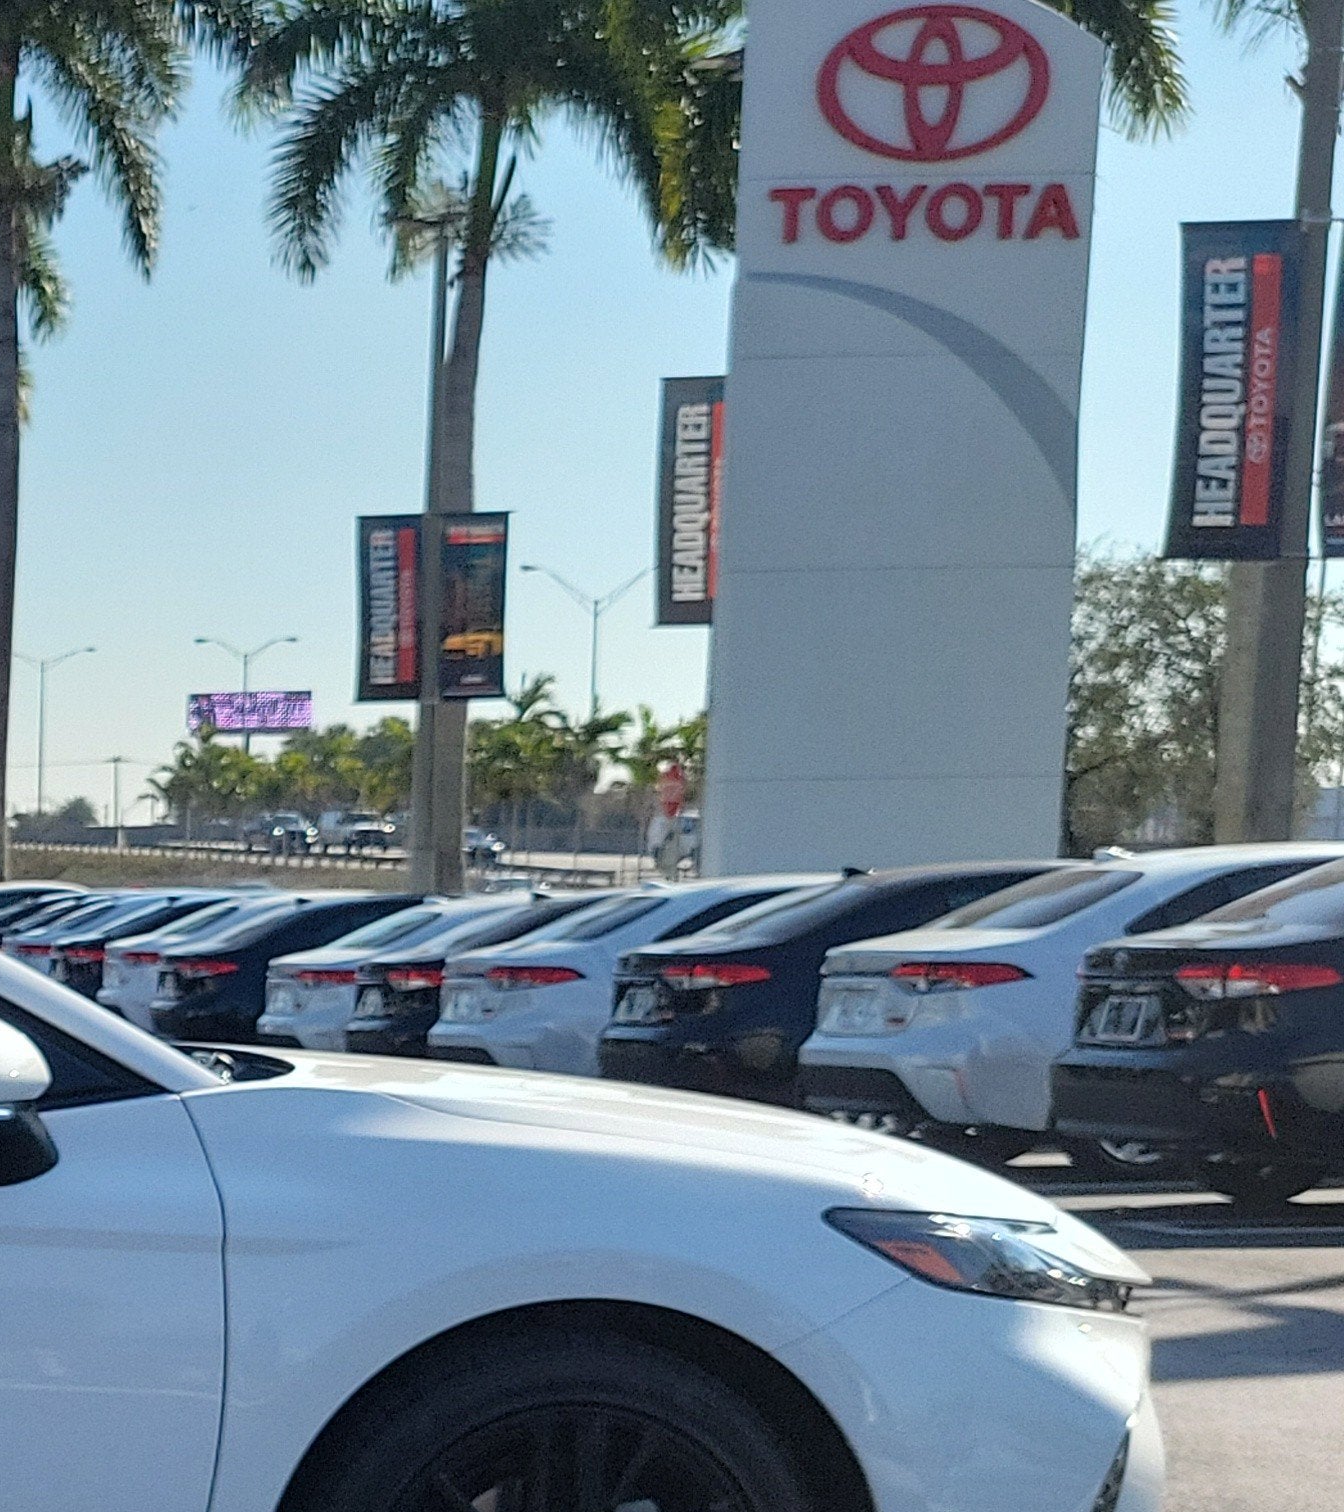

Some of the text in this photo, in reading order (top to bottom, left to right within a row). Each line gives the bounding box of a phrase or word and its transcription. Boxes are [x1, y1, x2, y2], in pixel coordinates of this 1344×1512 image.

[769, 182, 1081, 244] TOYOTA
[1190, 255, 1247, 527] HEADQUARTER
[1249, 327, 1272, 426] TOYOTA
[670, 404, 711, 602] HEADQUARTER
[369, 530, 397, 684] HEADQUARTER
